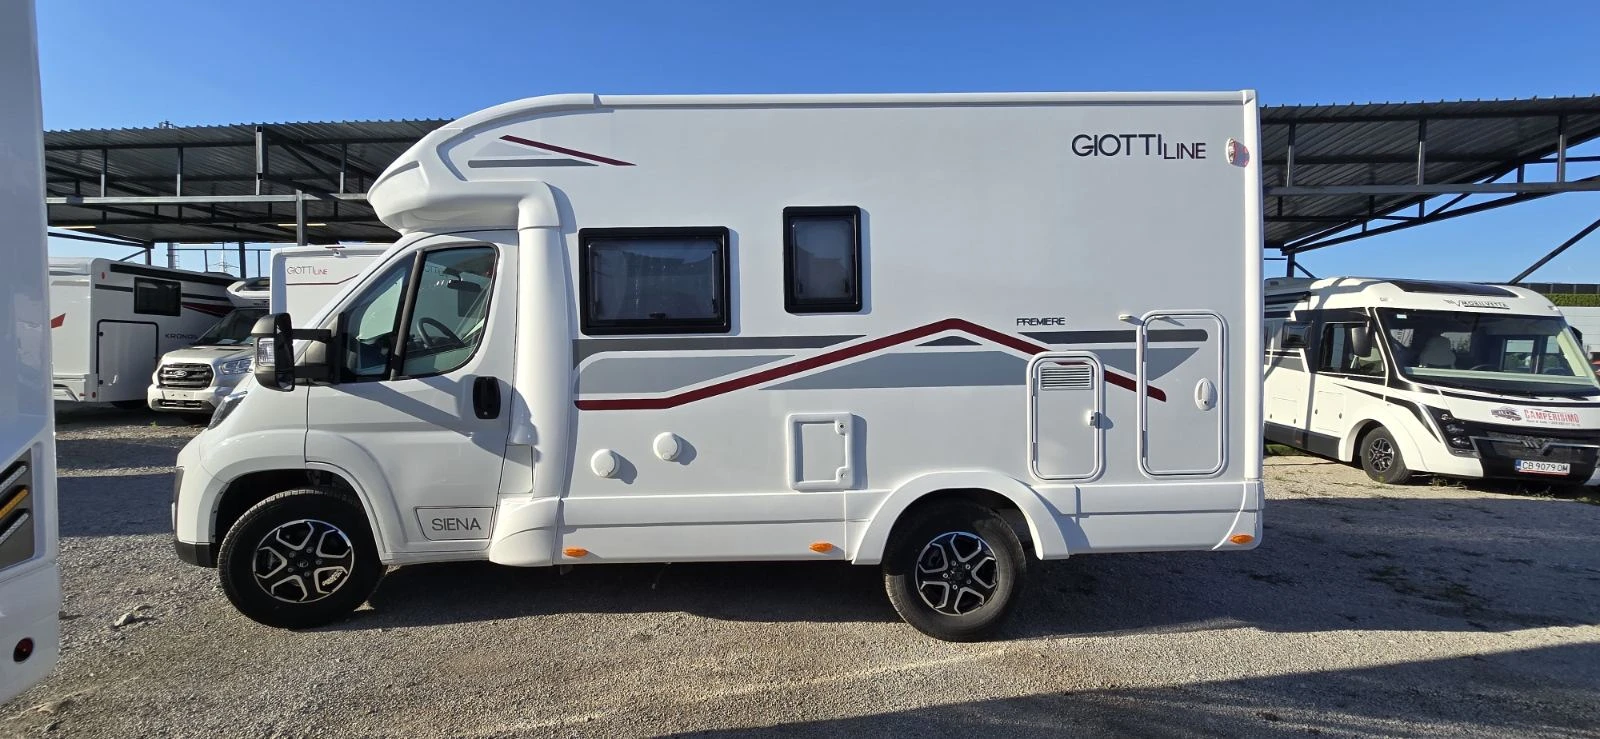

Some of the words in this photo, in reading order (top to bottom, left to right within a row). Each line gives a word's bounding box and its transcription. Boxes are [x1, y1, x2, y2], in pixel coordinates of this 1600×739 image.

[1016, 317, 1066, 326] PREMIERE
[1535, 463, 1555, 471] 9079
[431, 517, 482, 531] SIENA
